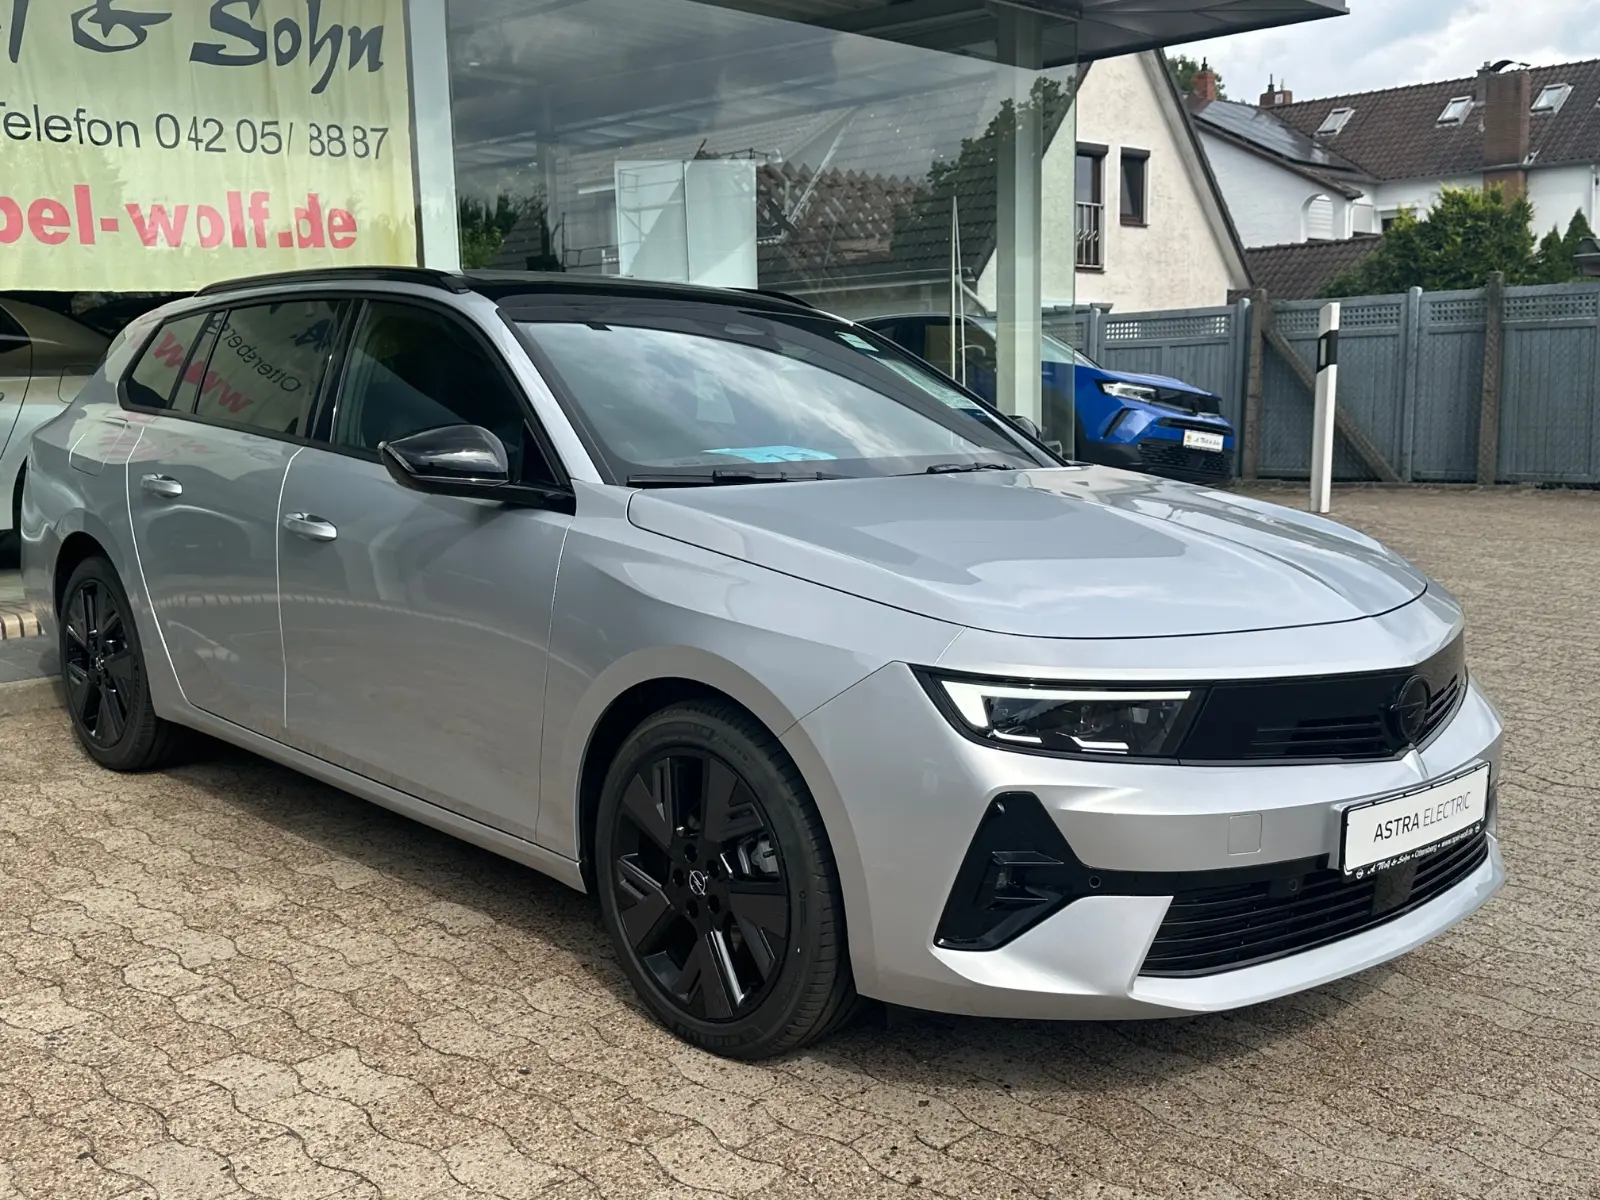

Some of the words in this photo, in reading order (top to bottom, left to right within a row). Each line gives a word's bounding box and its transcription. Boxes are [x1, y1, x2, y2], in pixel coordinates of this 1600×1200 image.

[189, 0, 385, 94] Sohn
[0, 103, 141, 149] elefon
[1373, 812, 1420, 842] ASTRA
[1423, 791, 1472, 827] ELECTRIC
